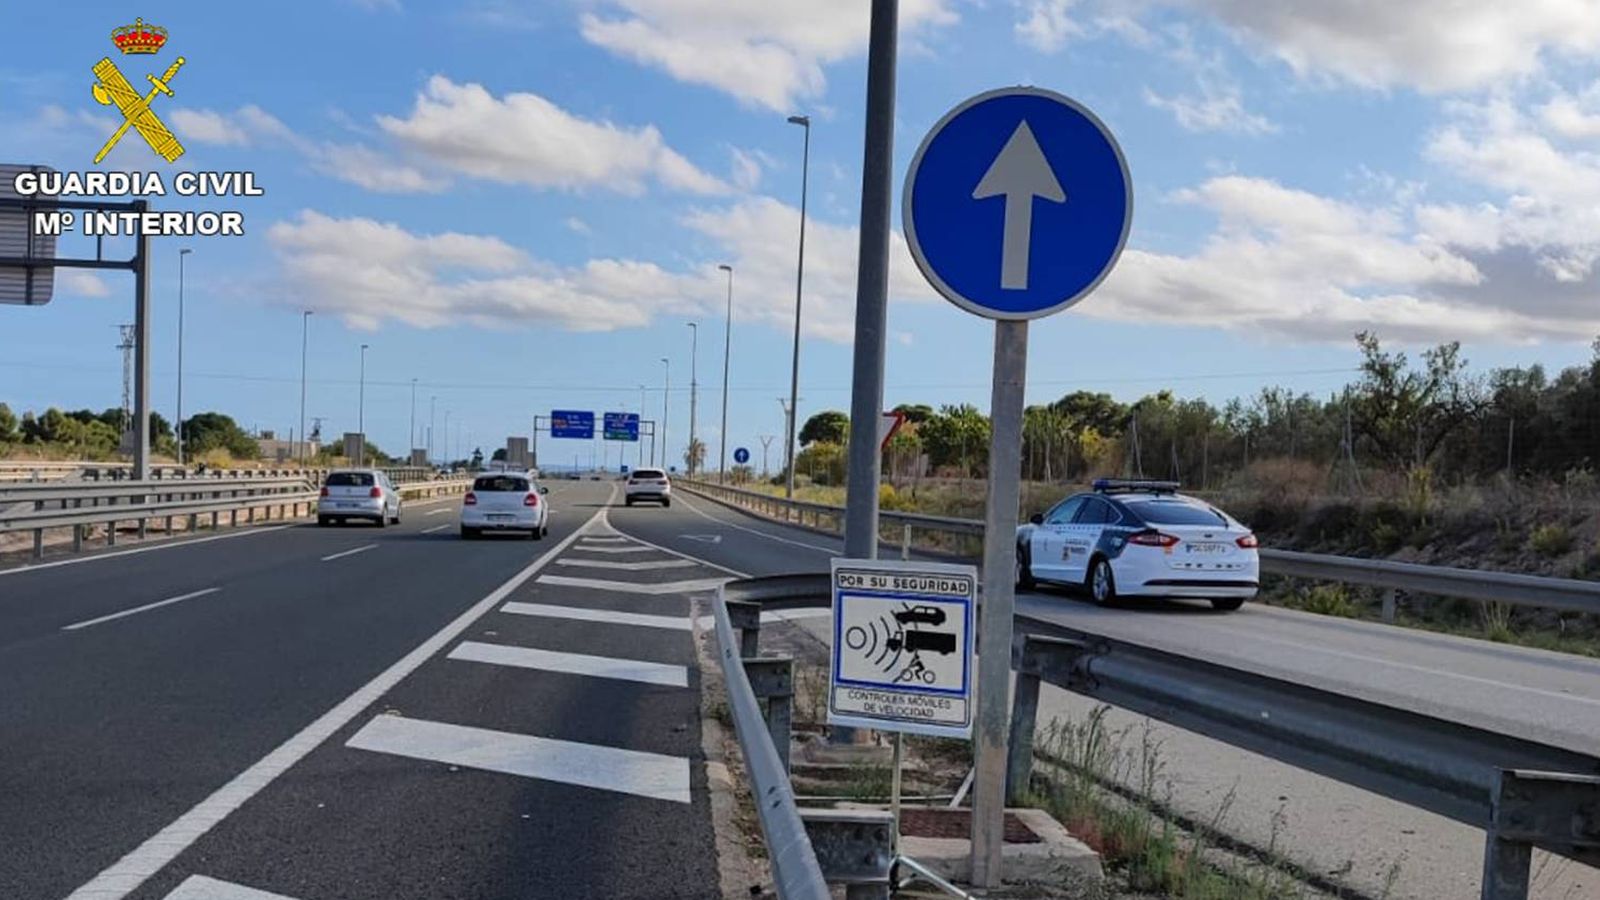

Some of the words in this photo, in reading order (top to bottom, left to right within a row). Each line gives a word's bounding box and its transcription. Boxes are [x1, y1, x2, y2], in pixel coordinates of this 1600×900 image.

[839, 575, 864, 586] POR
[870, 576, 887, 587] SU
[893, 578, 967, 593] SEGURIDAD
[848, 690, 905, 705] CONTROLES
[863, 702, 876, 713] DE
[879, 704, 934, 718] VELOCIDAD
